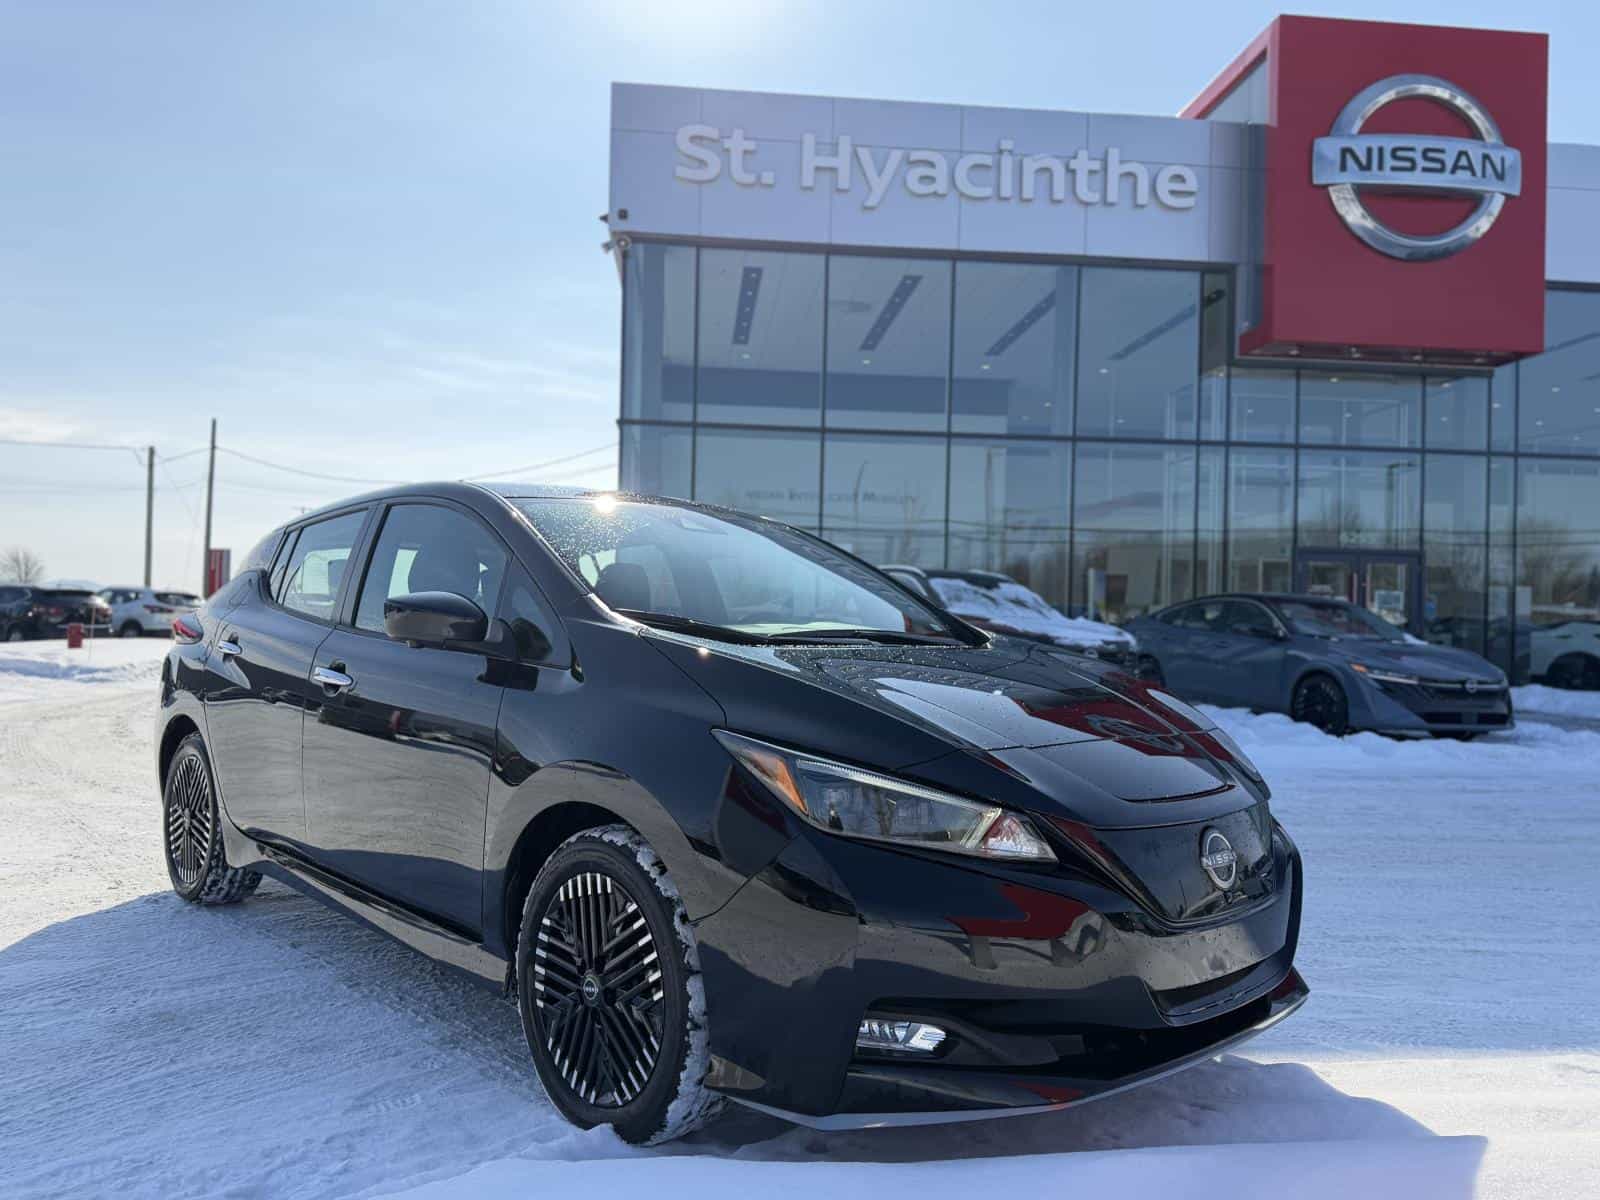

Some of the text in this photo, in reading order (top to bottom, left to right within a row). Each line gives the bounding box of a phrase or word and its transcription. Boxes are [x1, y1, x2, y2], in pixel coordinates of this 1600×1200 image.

[675, 125, 1198, 209] St. Hyacinthe
[1339, 146, 1506, 182] NISSAN
